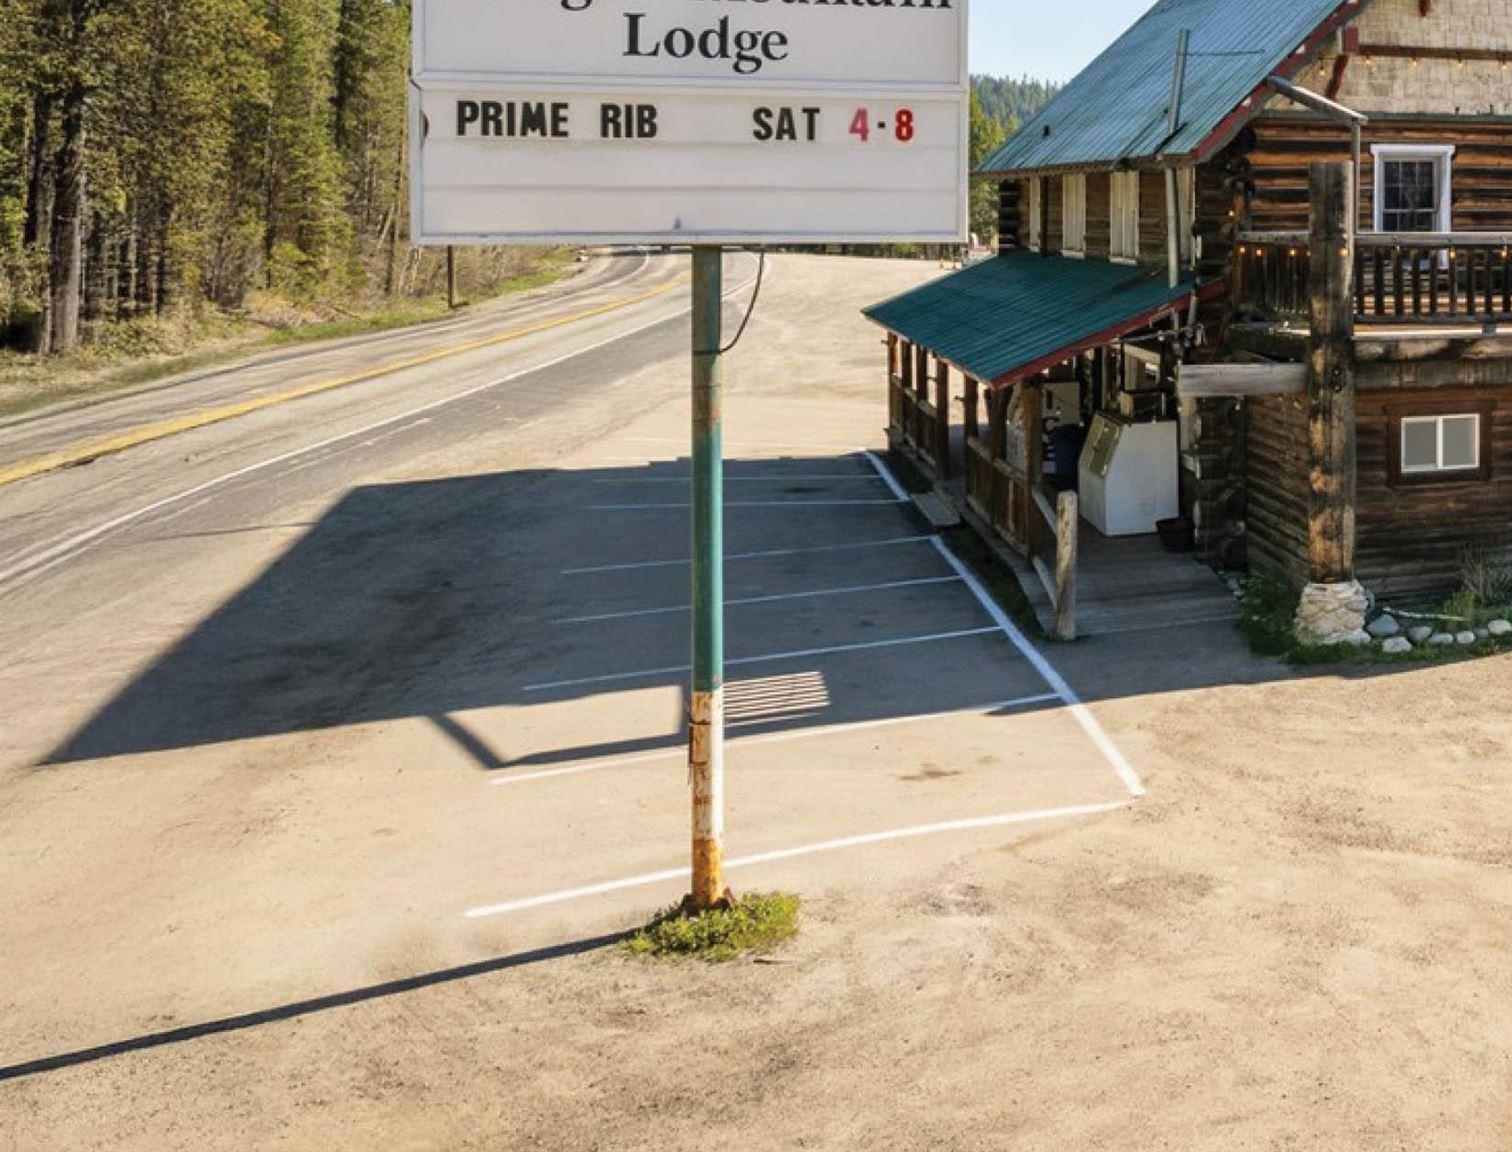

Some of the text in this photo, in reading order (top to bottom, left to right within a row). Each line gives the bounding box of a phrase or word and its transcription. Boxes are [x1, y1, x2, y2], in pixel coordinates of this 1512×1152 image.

[622, 12, 789, 75] Lodge
[455, 100, 569, 138] PRIME
[599, 103, 658, 139] RIB
[752, 106, 821, 141] SAT
